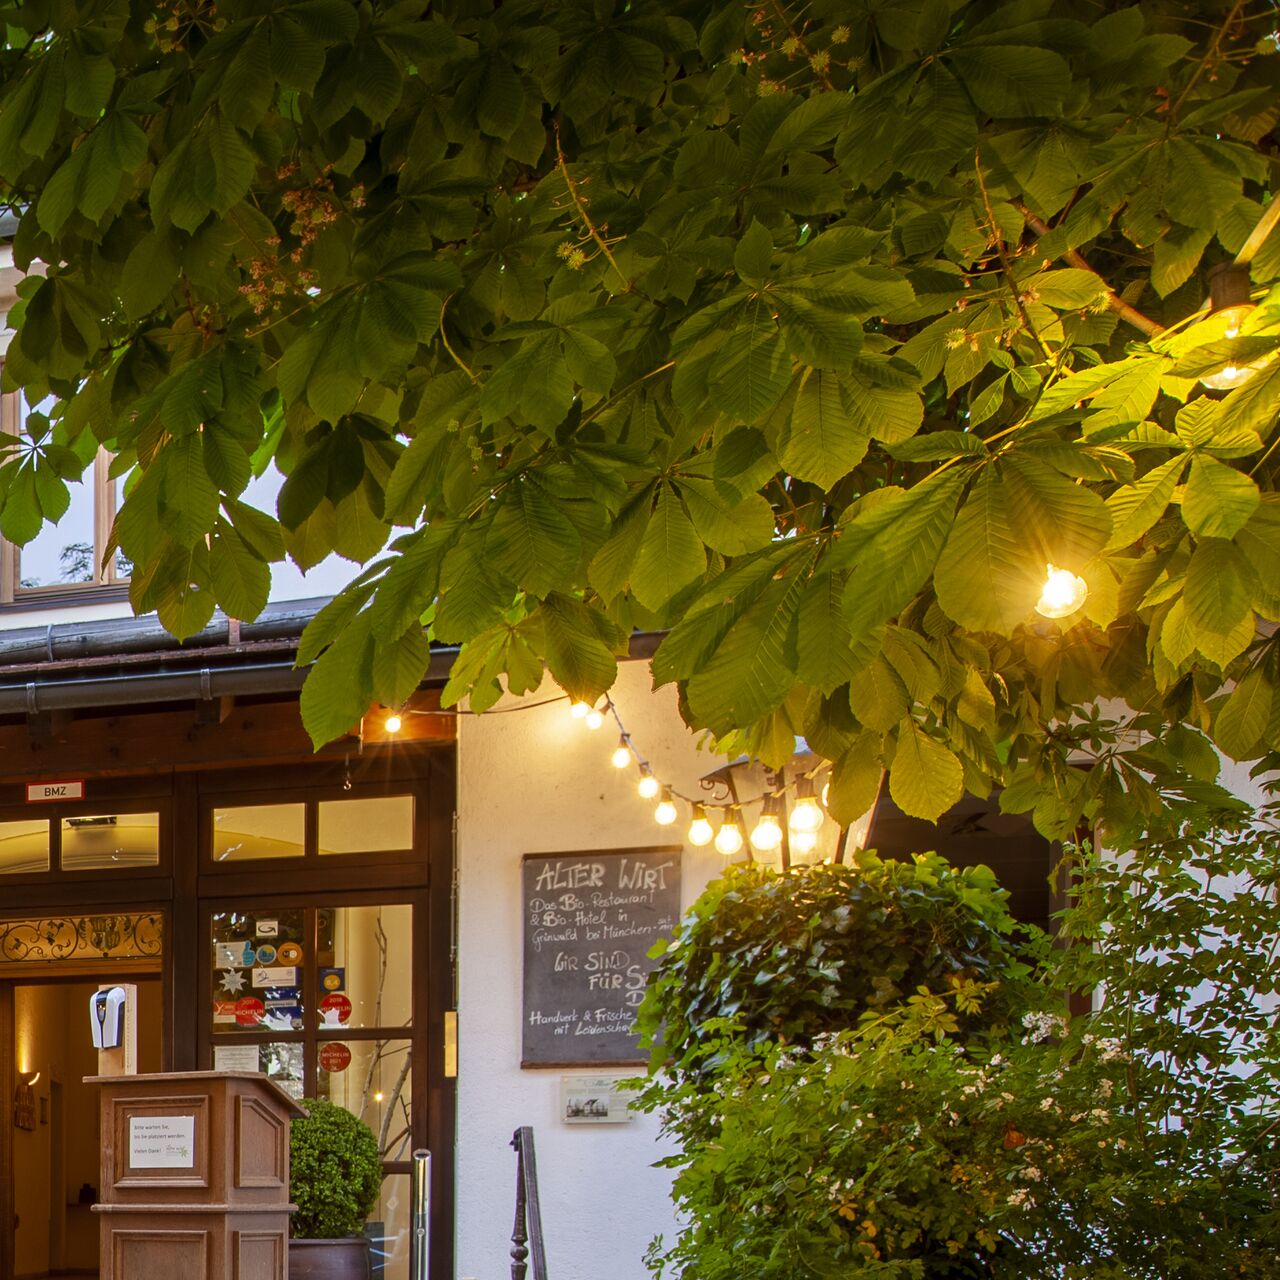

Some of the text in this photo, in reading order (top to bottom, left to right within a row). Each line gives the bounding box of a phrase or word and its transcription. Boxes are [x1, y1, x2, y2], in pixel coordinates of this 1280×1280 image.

[44, 786, 67, 797] BMZ
[535, 862, 605, 891] ALTER
[530, 898, 557, 913] Das
[530, 914, 540, 926] &
[618, 909, 628, 921] in
[586, 927, 600, 940] bei
[588, 973, 623, 990] FÜR
[529, 1008, 634, 1025] Handwerk & Frische
[554, 1019, 641, 1036] mit Leidenschaf
